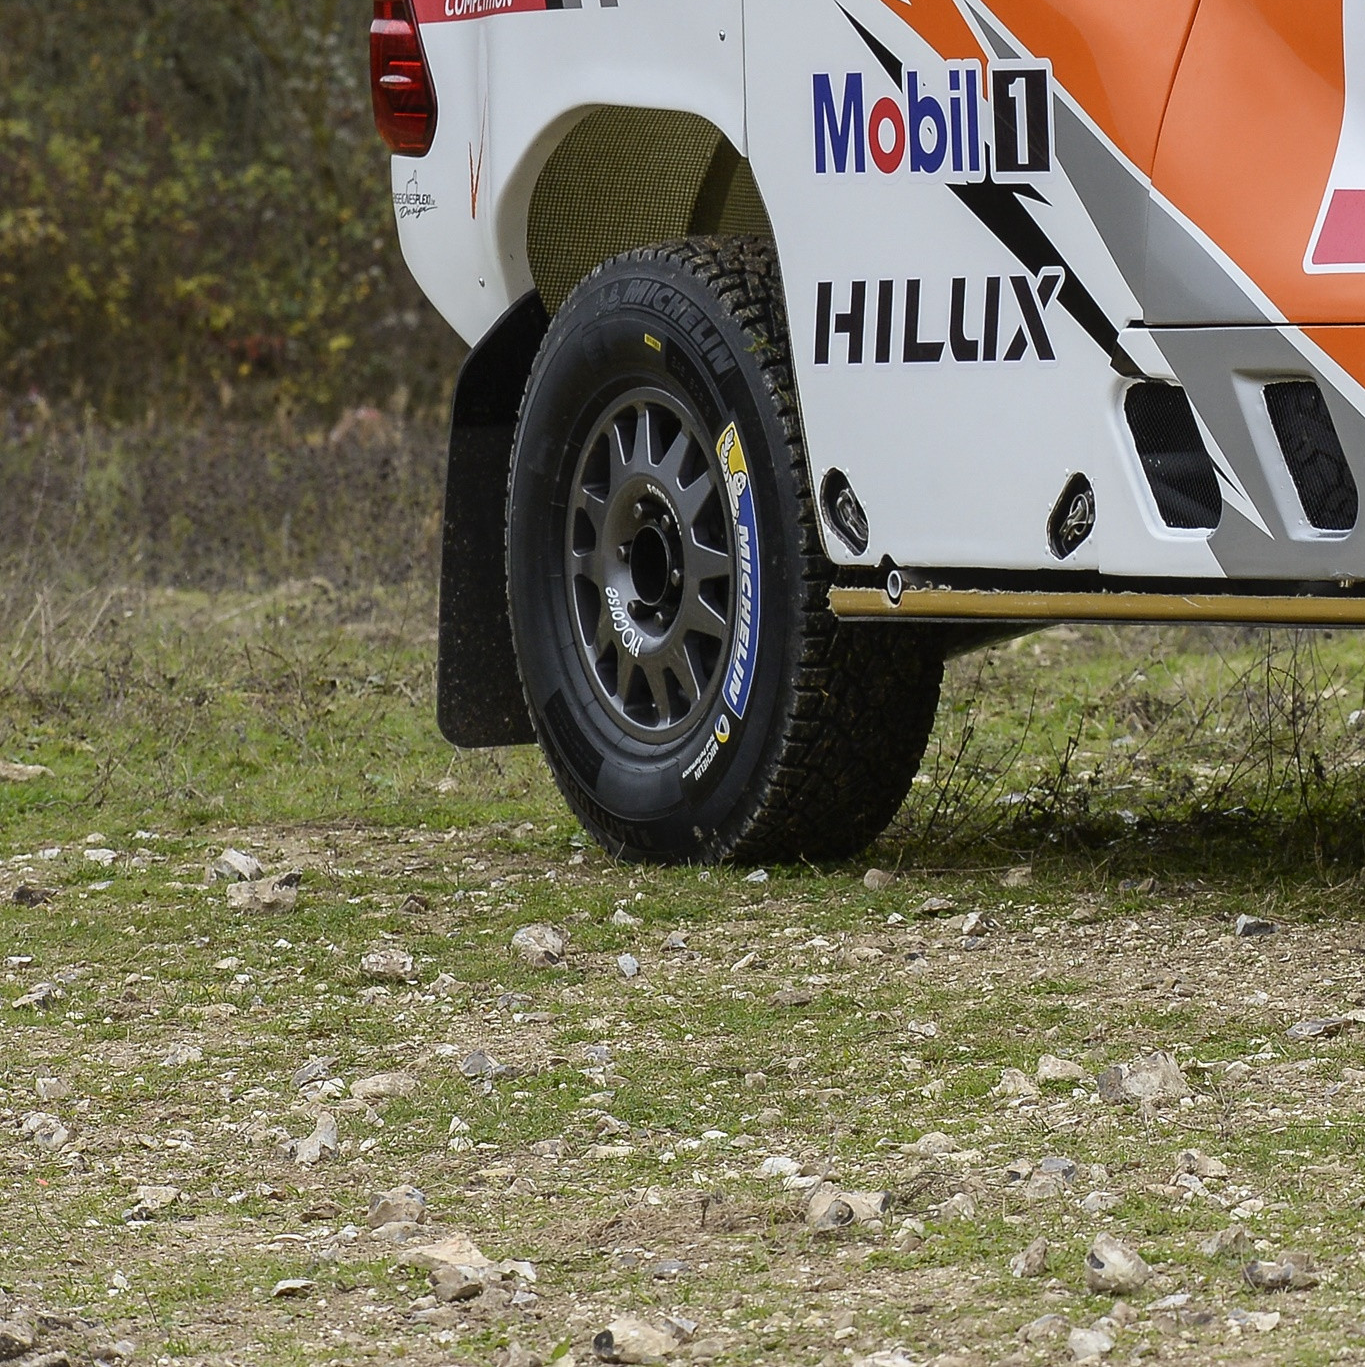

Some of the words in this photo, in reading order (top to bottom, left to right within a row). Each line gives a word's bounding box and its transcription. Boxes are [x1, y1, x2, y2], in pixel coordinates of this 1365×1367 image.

[812, 70, 981, 174] Mobil
[621, 279, 737, 376] MICHELIN
[814, 274, 1063, 365] HILUX
[728, 524, 753, 706] MICHELIN
[694, 740, 719, 781] MICHELIN
